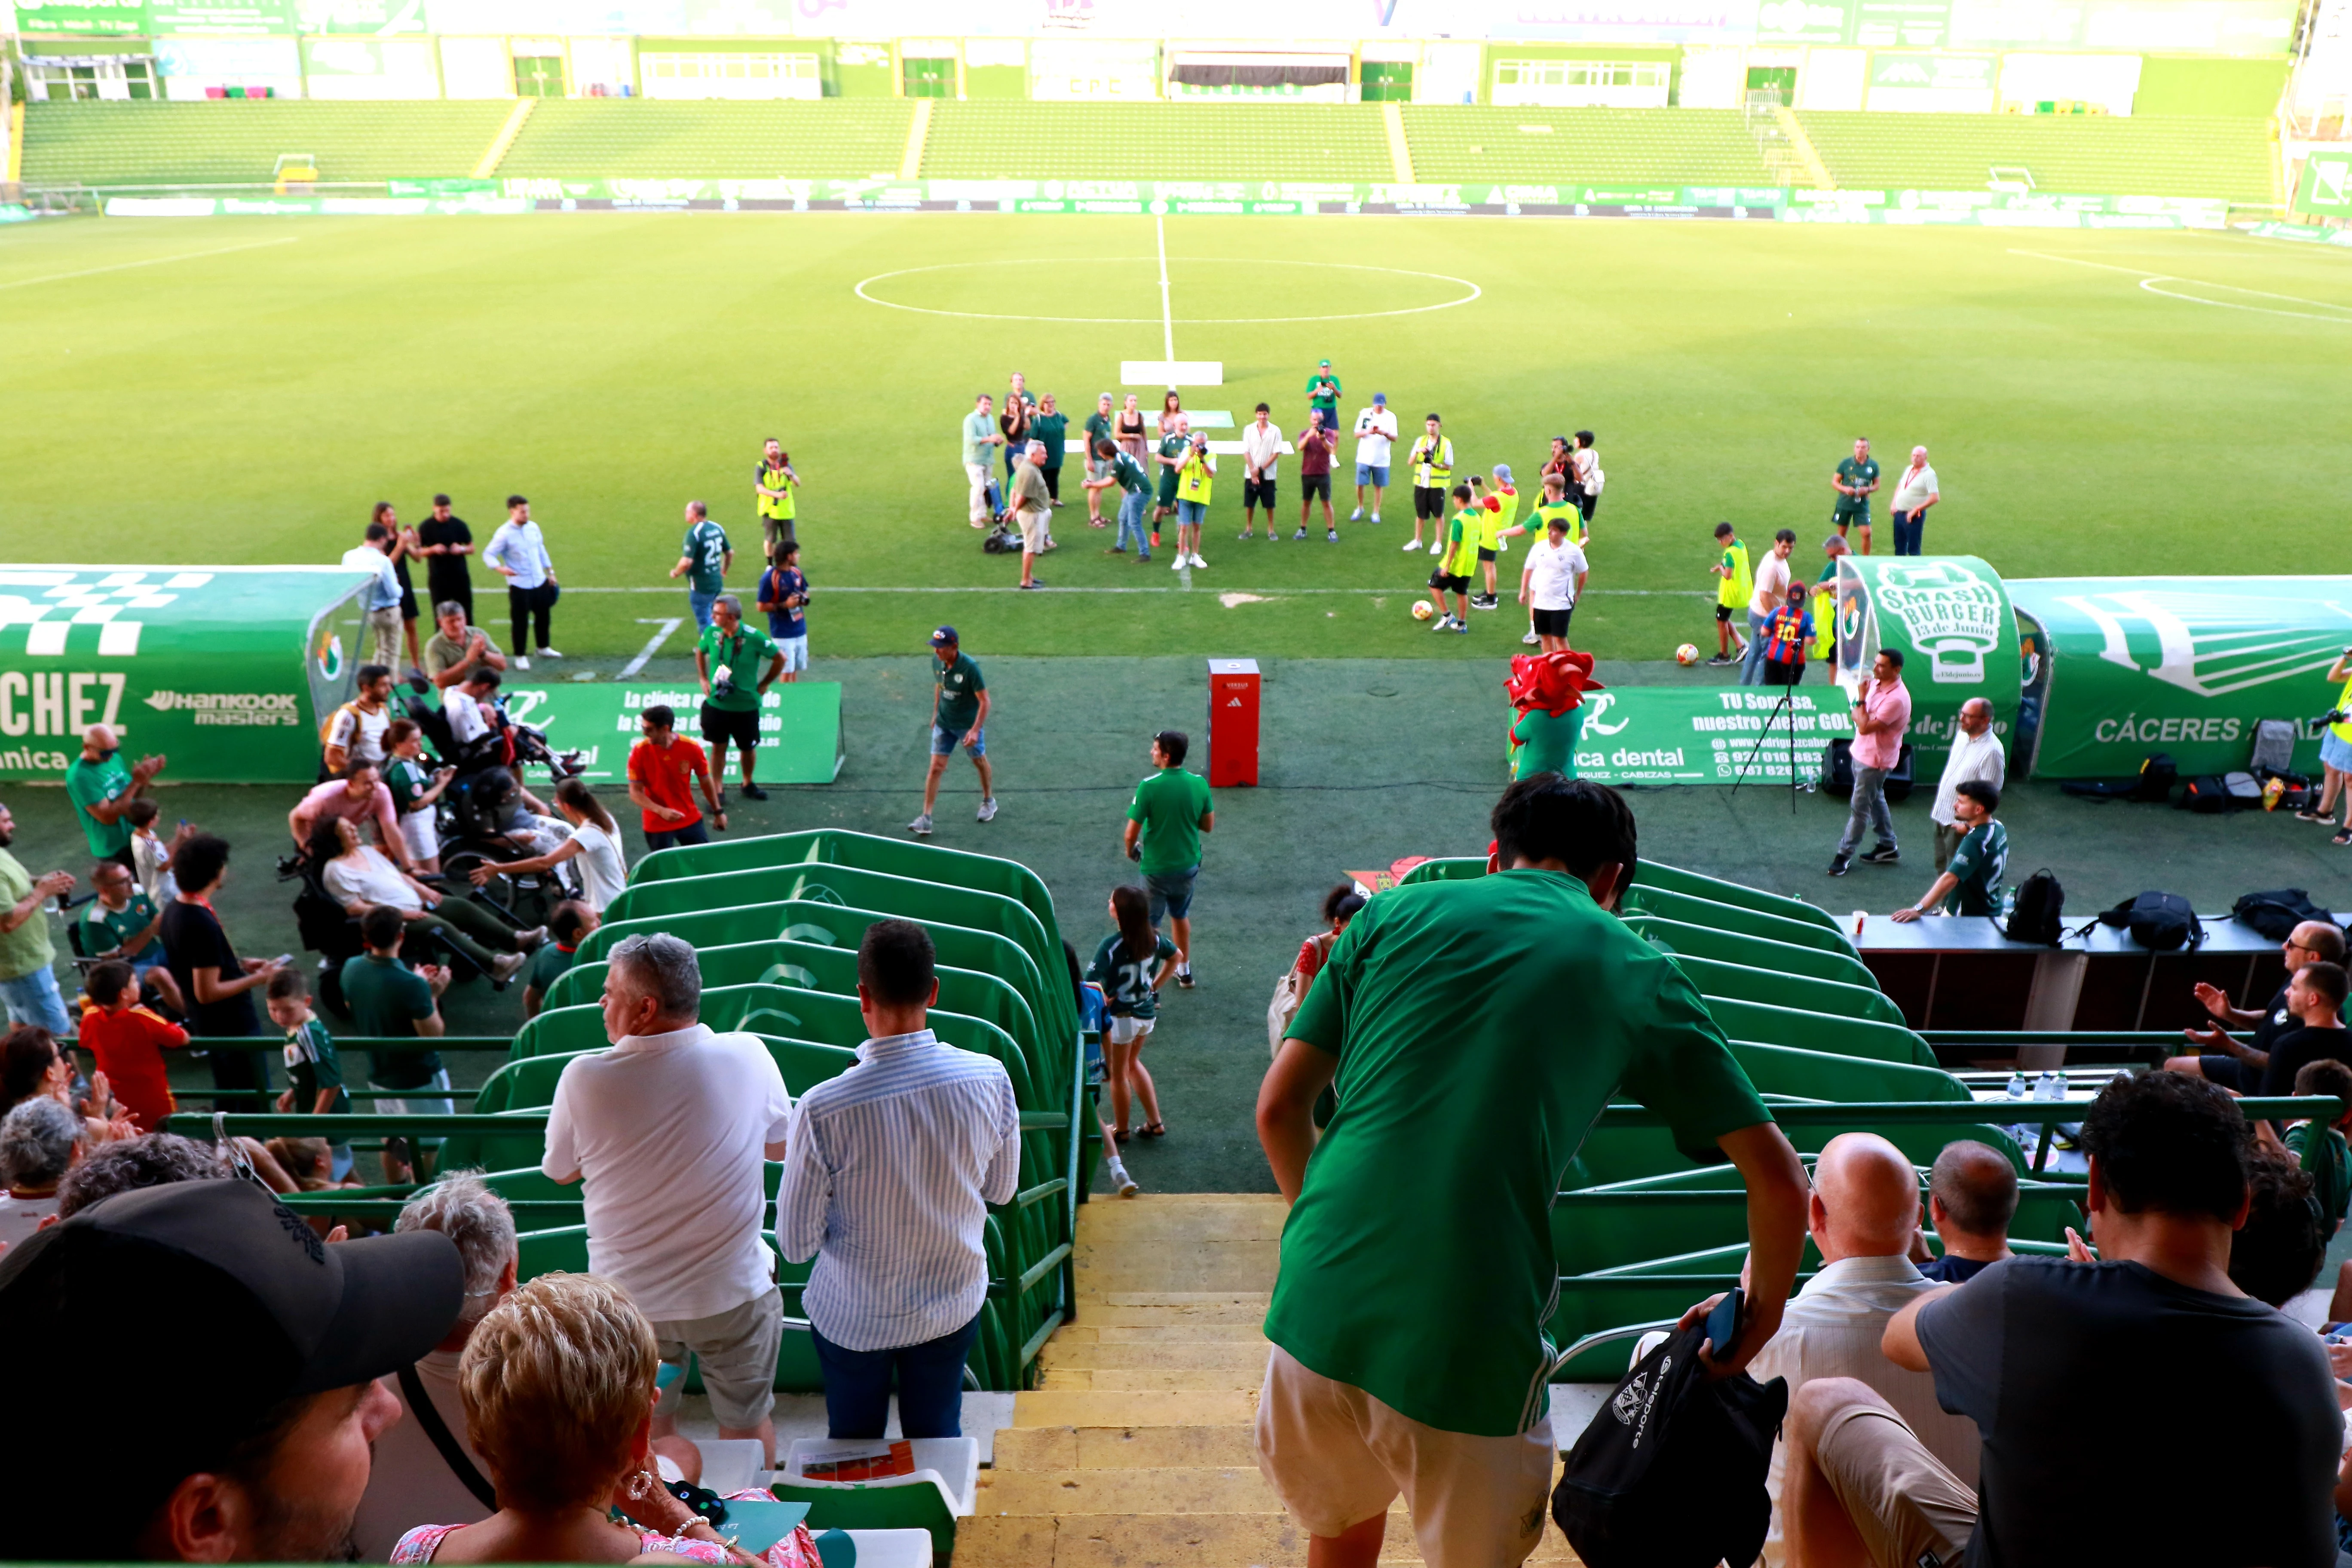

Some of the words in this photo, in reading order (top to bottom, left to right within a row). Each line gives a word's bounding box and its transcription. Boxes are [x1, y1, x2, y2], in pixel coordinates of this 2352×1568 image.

[1882, 584, 1995, 609] SMASH
[1903, 603, 1995, 625] BURGER
[1777, 623, 1796, 642] 10
[1915, 625, 1930, 637] 13
[1933, 623, 1949, 633] de
[1954, 623, 1994, 637] Junio
[624, 691, 640, 708] La
[643, 690, 691, 708] clínica
[1719, 693, 1743, 709] TU
[1693, 714, 1761, 731] nuestro
[1819, 713, 1853, 730] GOL
[2095, 713, 2241, 742] CÁCERES
[1612, 747, 1684, 766] dental
[1733, 751, 1759, 763] 927
[1763, 752, 1789, 763] 010
